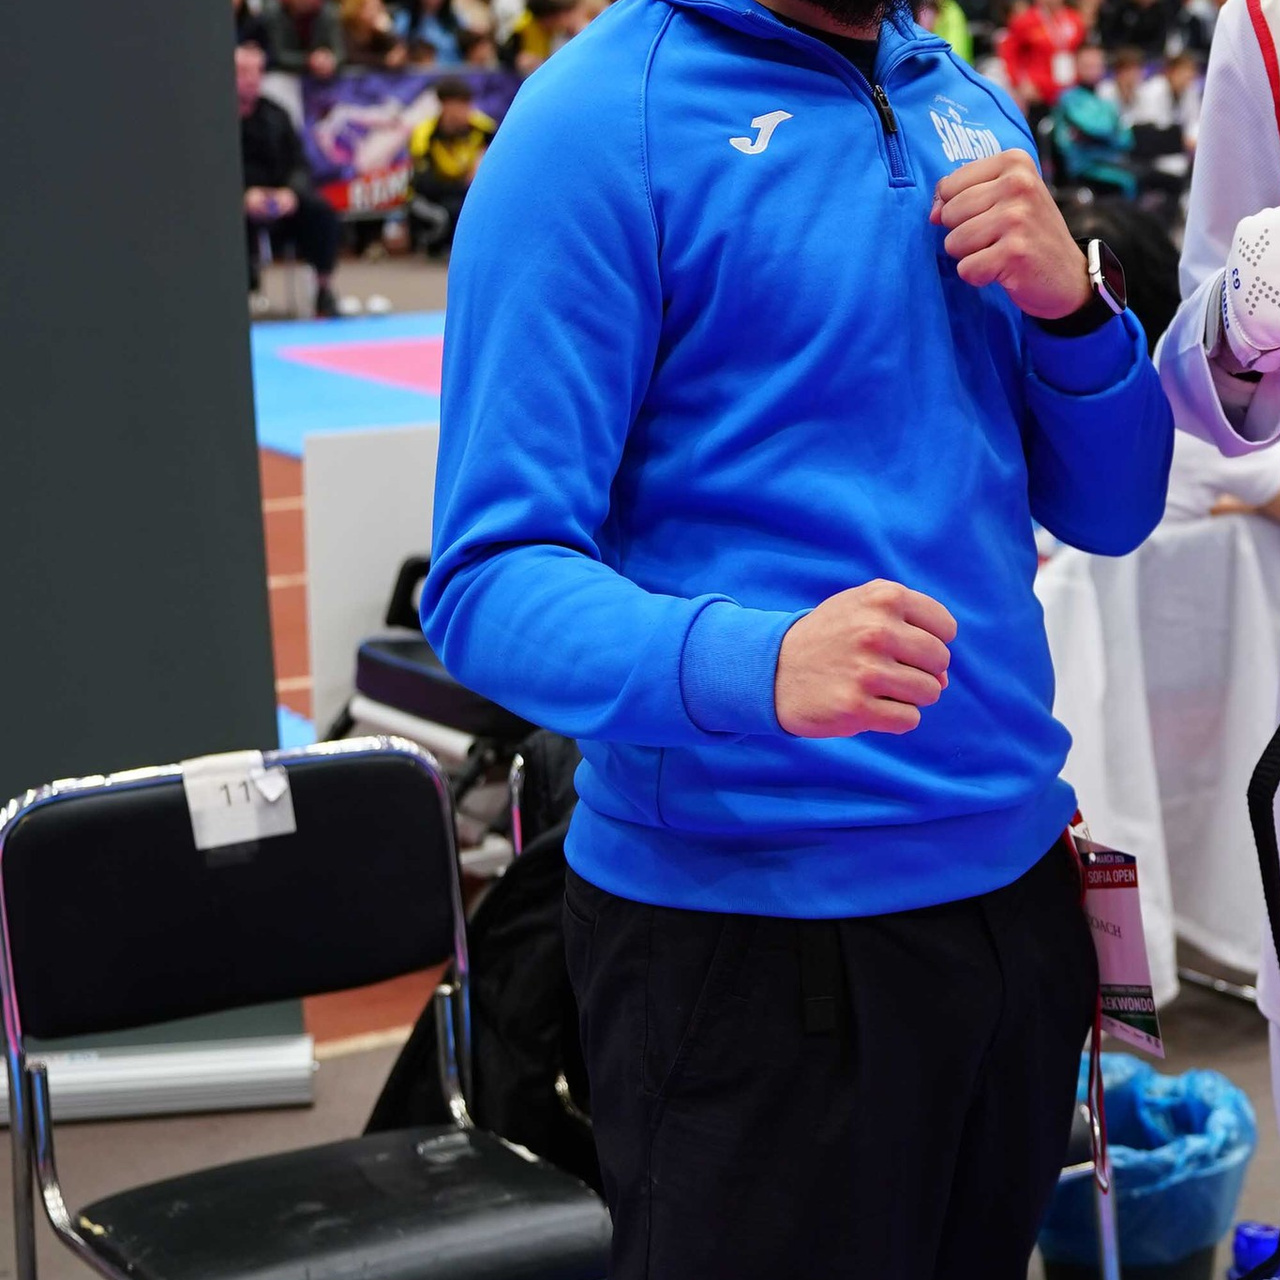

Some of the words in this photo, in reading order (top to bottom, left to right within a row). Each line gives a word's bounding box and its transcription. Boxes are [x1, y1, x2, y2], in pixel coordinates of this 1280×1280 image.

[219, 781, 251, 807] 11
[1087, 870, 1111, 884] SOFIA
[1112, 869, 1135, 882] OPEN
[1091, 917, 1122, 938] OACH
